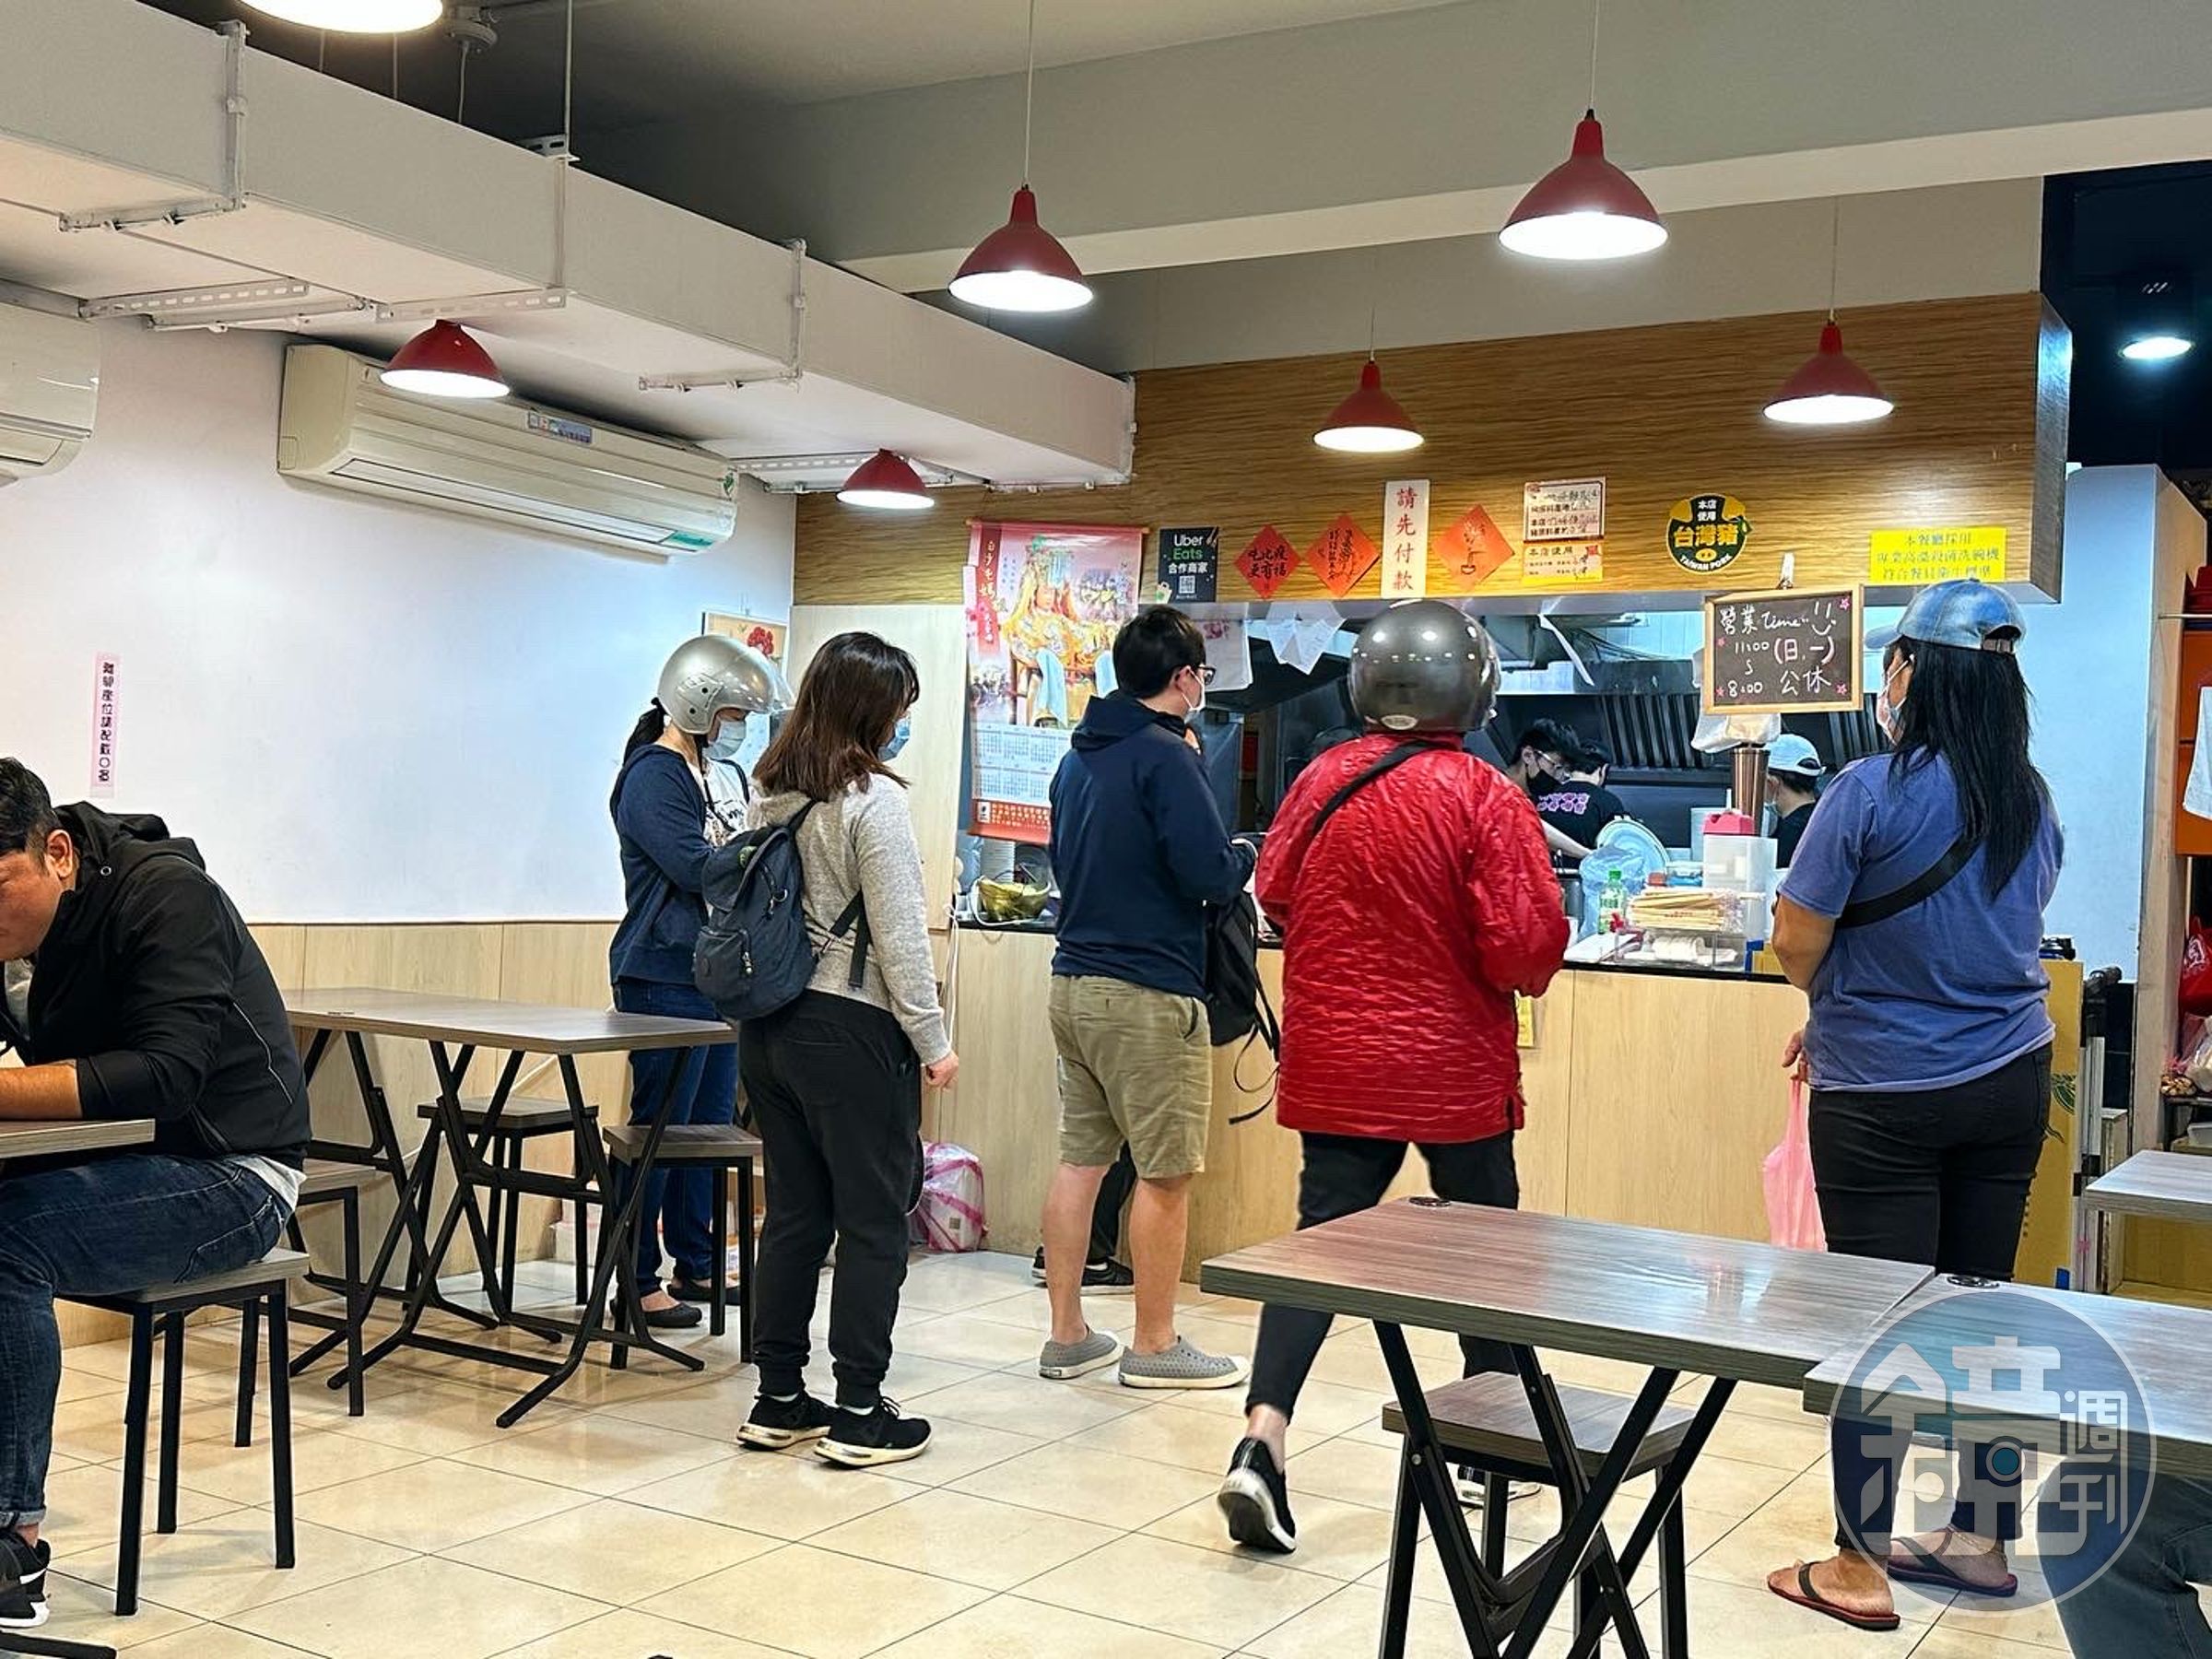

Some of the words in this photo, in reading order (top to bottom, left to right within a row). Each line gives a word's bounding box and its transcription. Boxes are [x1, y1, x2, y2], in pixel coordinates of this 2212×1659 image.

[1698, 499, 1716, 510] 本店
[1698, 511, 1716, 522] 使用
[1174, 534, 1204, 547] Uber
[1393, 486, 1418, 591] 請先付款
[1674, 524, 1738, 547] 台灣豬
[1172, 547, 1204, 560] Eats
[1680, 554, 1709, 571] TAIWAN
[1710, 553, 1733, 569] PORK
[1168, 561, 1208, 574] 合作商家
[1720, 603, 1759, 635] 營業
[1727, 679, 1764, 698] 8:00
[1780, 665, 1832, 697] 公休
